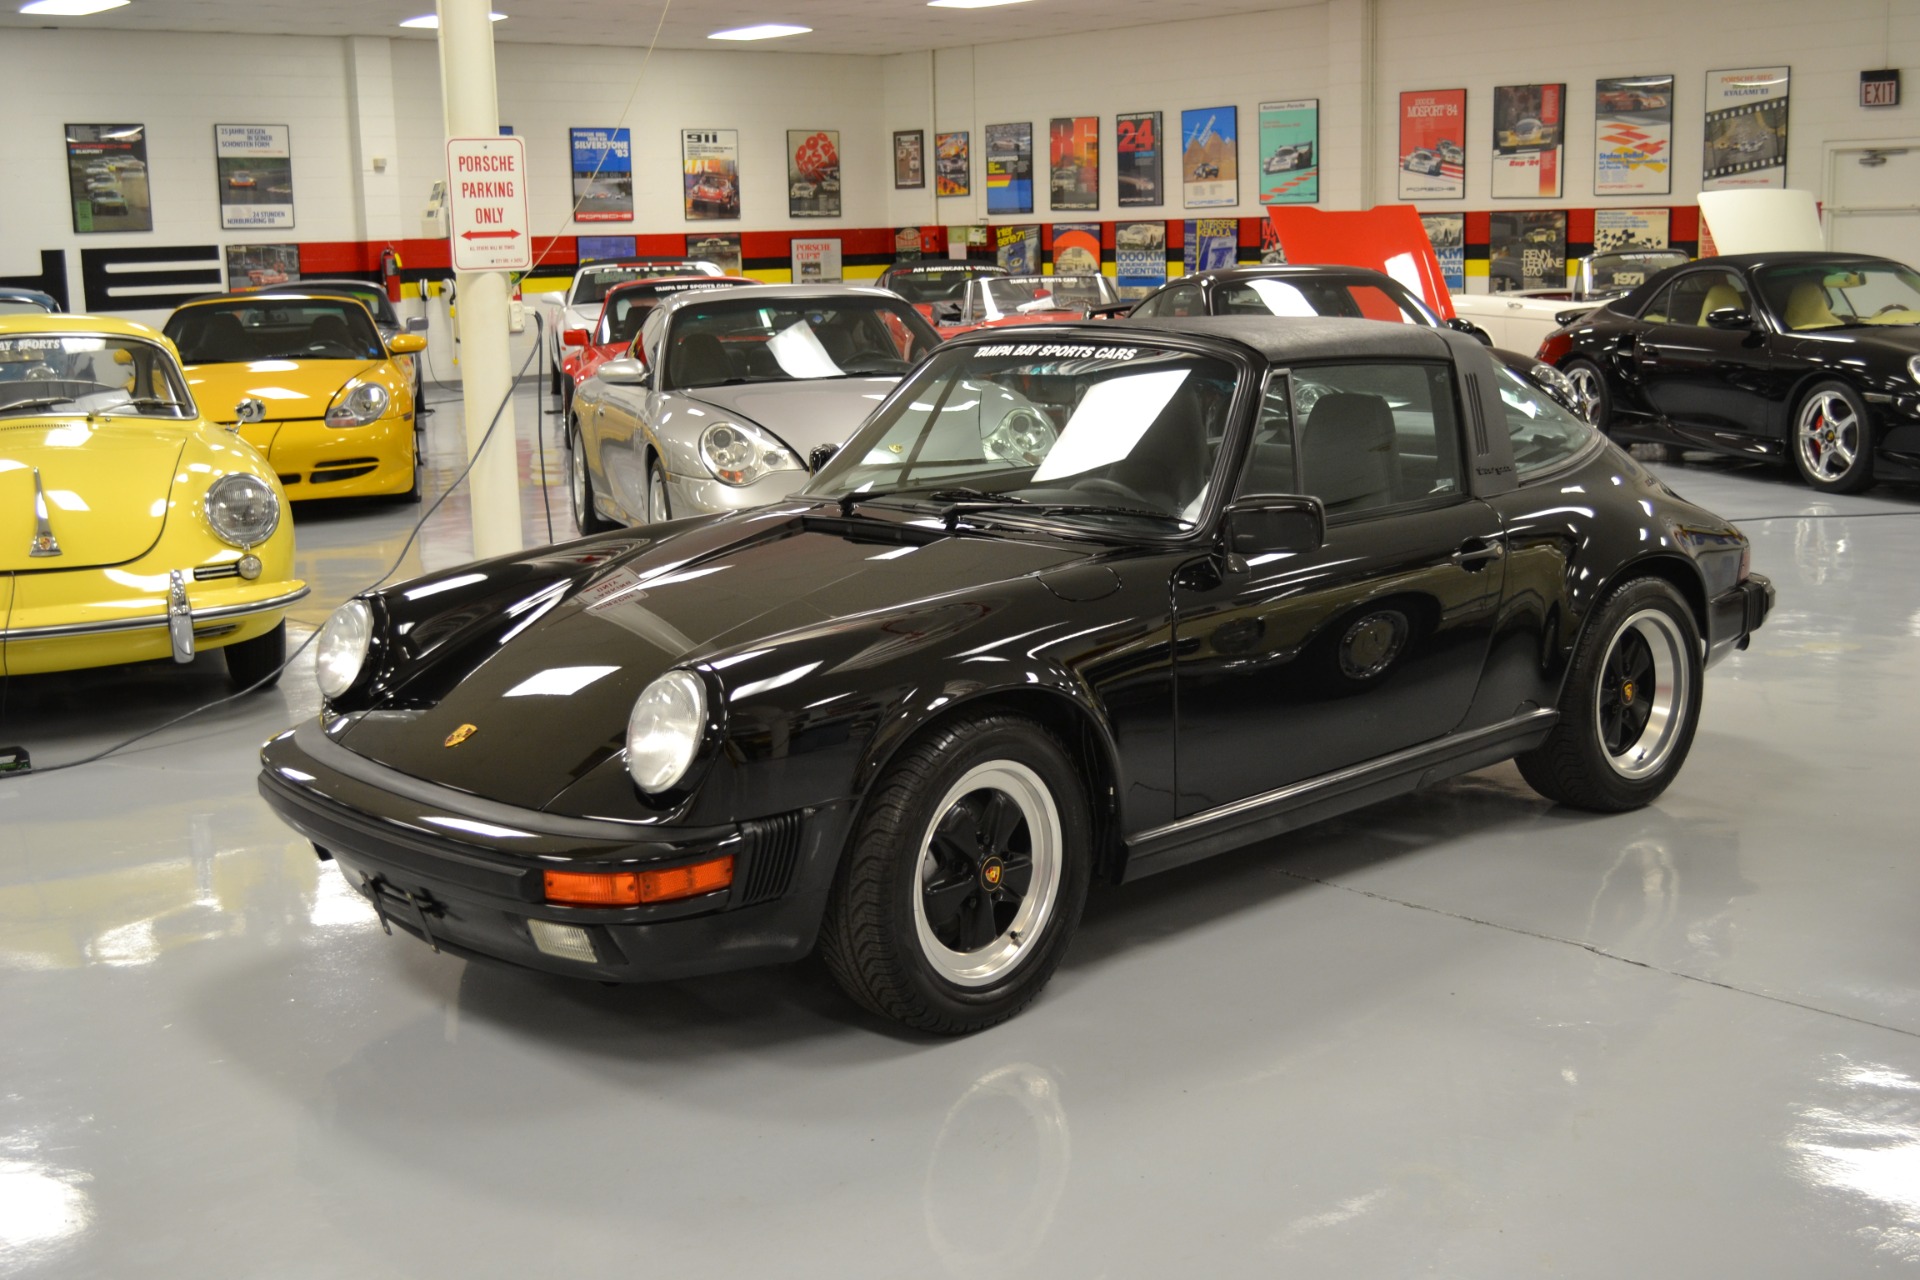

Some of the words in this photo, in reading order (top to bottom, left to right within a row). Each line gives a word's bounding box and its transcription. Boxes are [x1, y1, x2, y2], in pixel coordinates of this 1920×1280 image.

[1864, 82, 1894, 104] EXIT
[1408, 106, 1444, 118] MOSPORT
[687, 134, 718, 144] 911
[1118, 118, 1154, 152] 24
[574, 141, 628, 150] SILVERSTONE
[458, 156, 514, 172] PORSCHE
[462, 182, 514, 198] PARKING
[475, 208, 504, 224] ONLY
[1523, 249, 1551, 259] RENN
[1521, 258, 1564, 268] TERMINE
[1522, 267, 1543, 276] 1970
[1613, 272, 1645, 285] 1971
[18, 339, 60, 350] SPORTS
[974, 345, 1014, 358] TAMPA
[1012, 345, 1042, 356] BAY
[1038, 345, 1096, 358] SPORTS
[1094, 348, 1138, 361] CARS
